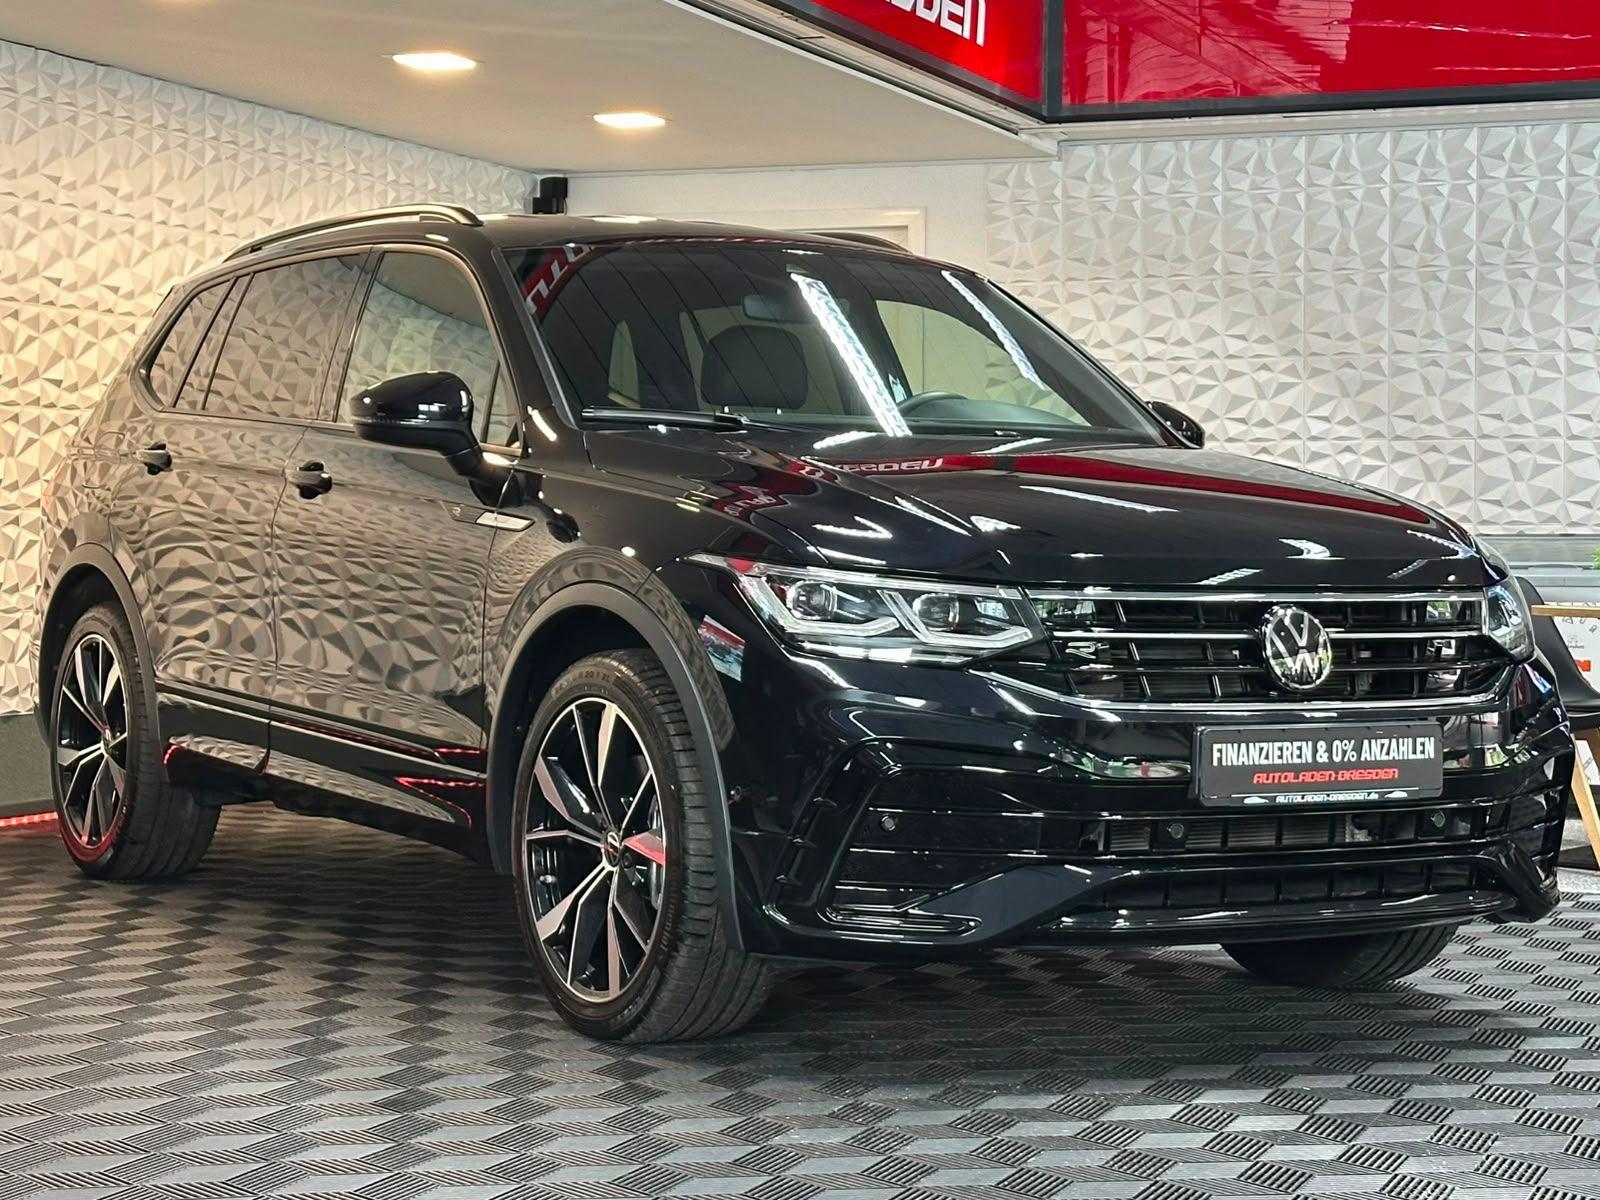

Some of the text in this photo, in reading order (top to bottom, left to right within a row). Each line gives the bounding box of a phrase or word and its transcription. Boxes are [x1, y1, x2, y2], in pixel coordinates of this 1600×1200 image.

[1212, 737, 1435, 766] FINANZIEREN & 0% ANZAHLEN
